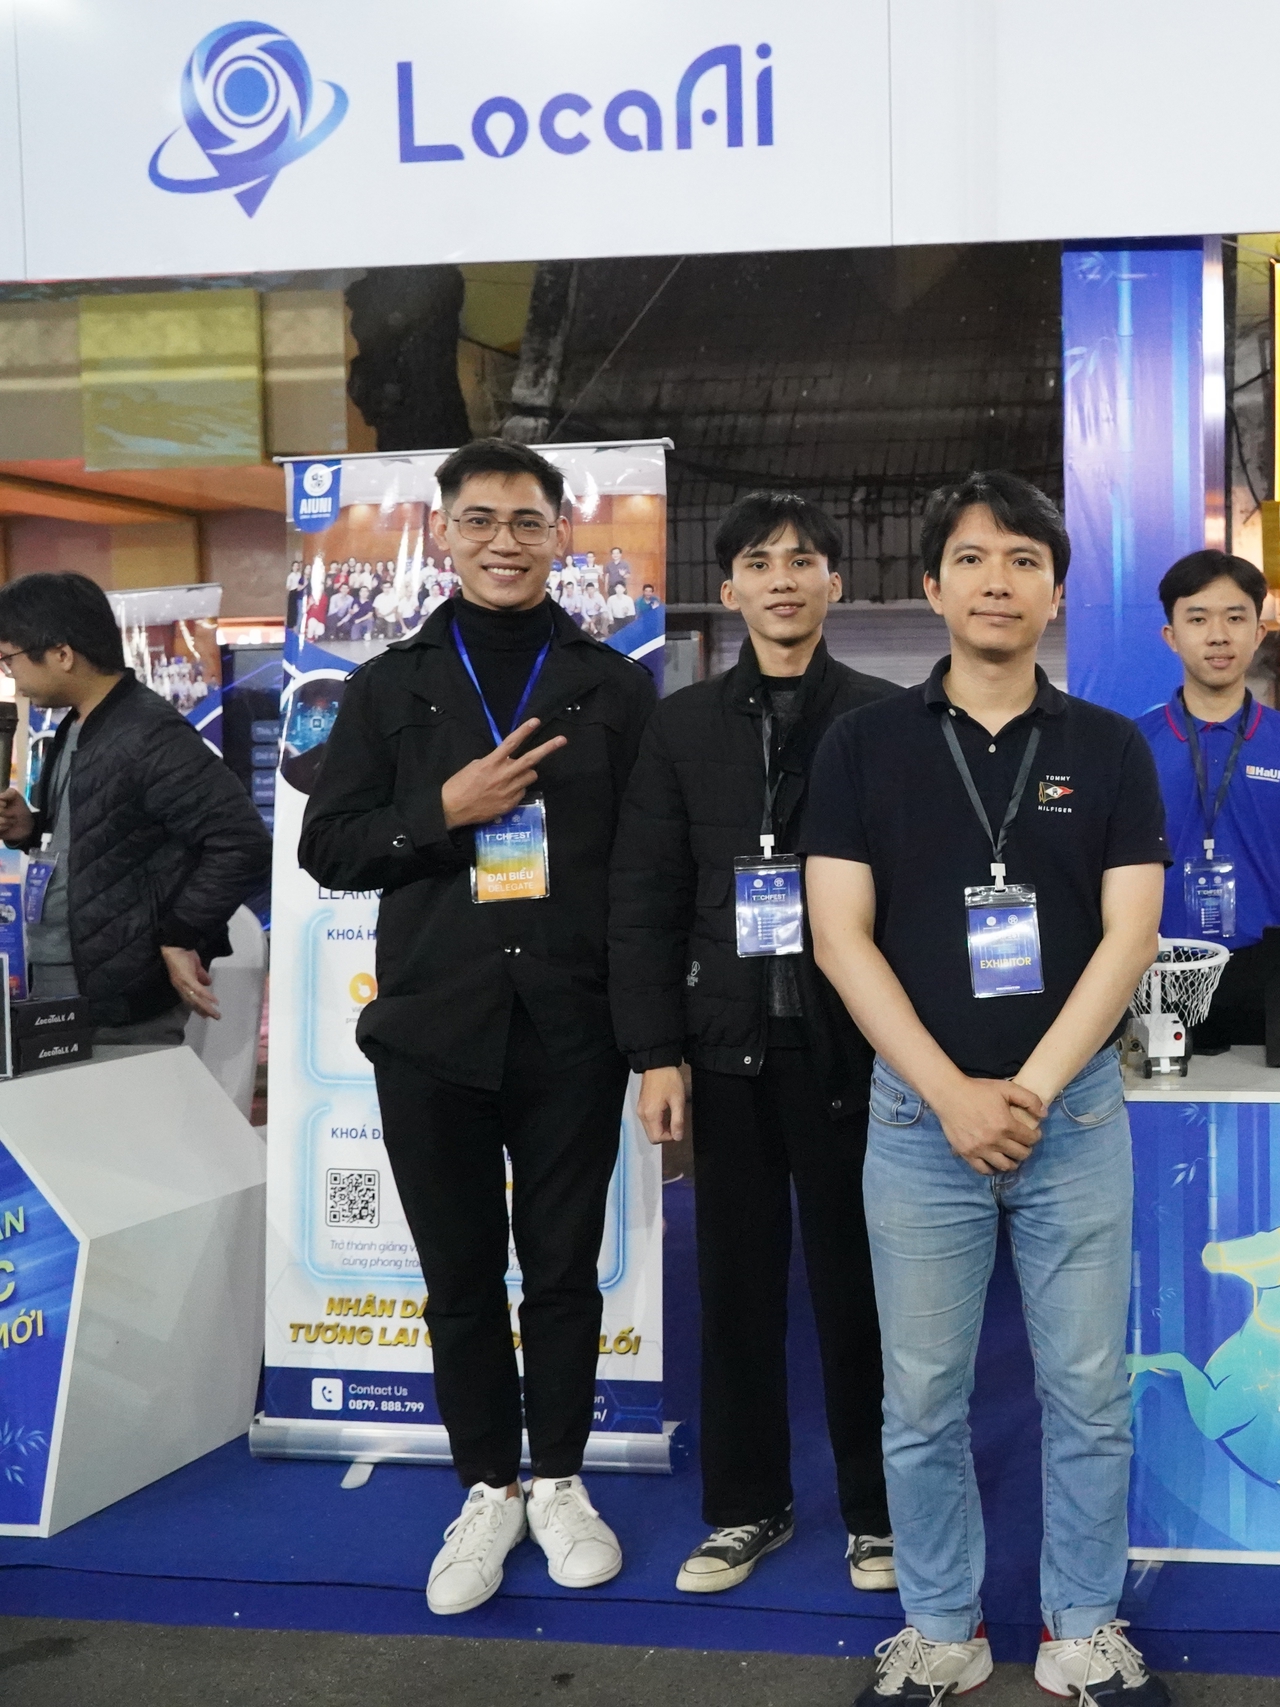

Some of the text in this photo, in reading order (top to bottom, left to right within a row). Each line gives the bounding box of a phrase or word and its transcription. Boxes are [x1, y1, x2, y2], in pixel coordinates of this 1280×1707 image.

[299, 497, 332, 515] AIUNI
[1037, 805, 1072, 814] HILFIGER
[488, 881, 534, 893] DELEGATE
[327, 925, 364, 941] KHOÁ
[980, 956, 1032, 969] EXHIBITOR
[330, 1123, 368, 1140] KHOÁ
[346, 1239, 377, 1251] thành
[378, 1241, 408, 1255] giảng
[342, 1258, 368, 1269] cùng
[369, 1258, 403, 1270] phong
[325, 1290, 396, 1318] NHÂN
[289, 1322, 374, 1346] TƯƠNG
[378, 1326, 420, 1347] LAI
[599, 1326, 642, 1355] LỐI
[348, 1383, 409, 1397] Contact Us
[348, 1399, 425, 1413] 0879. 888.799
